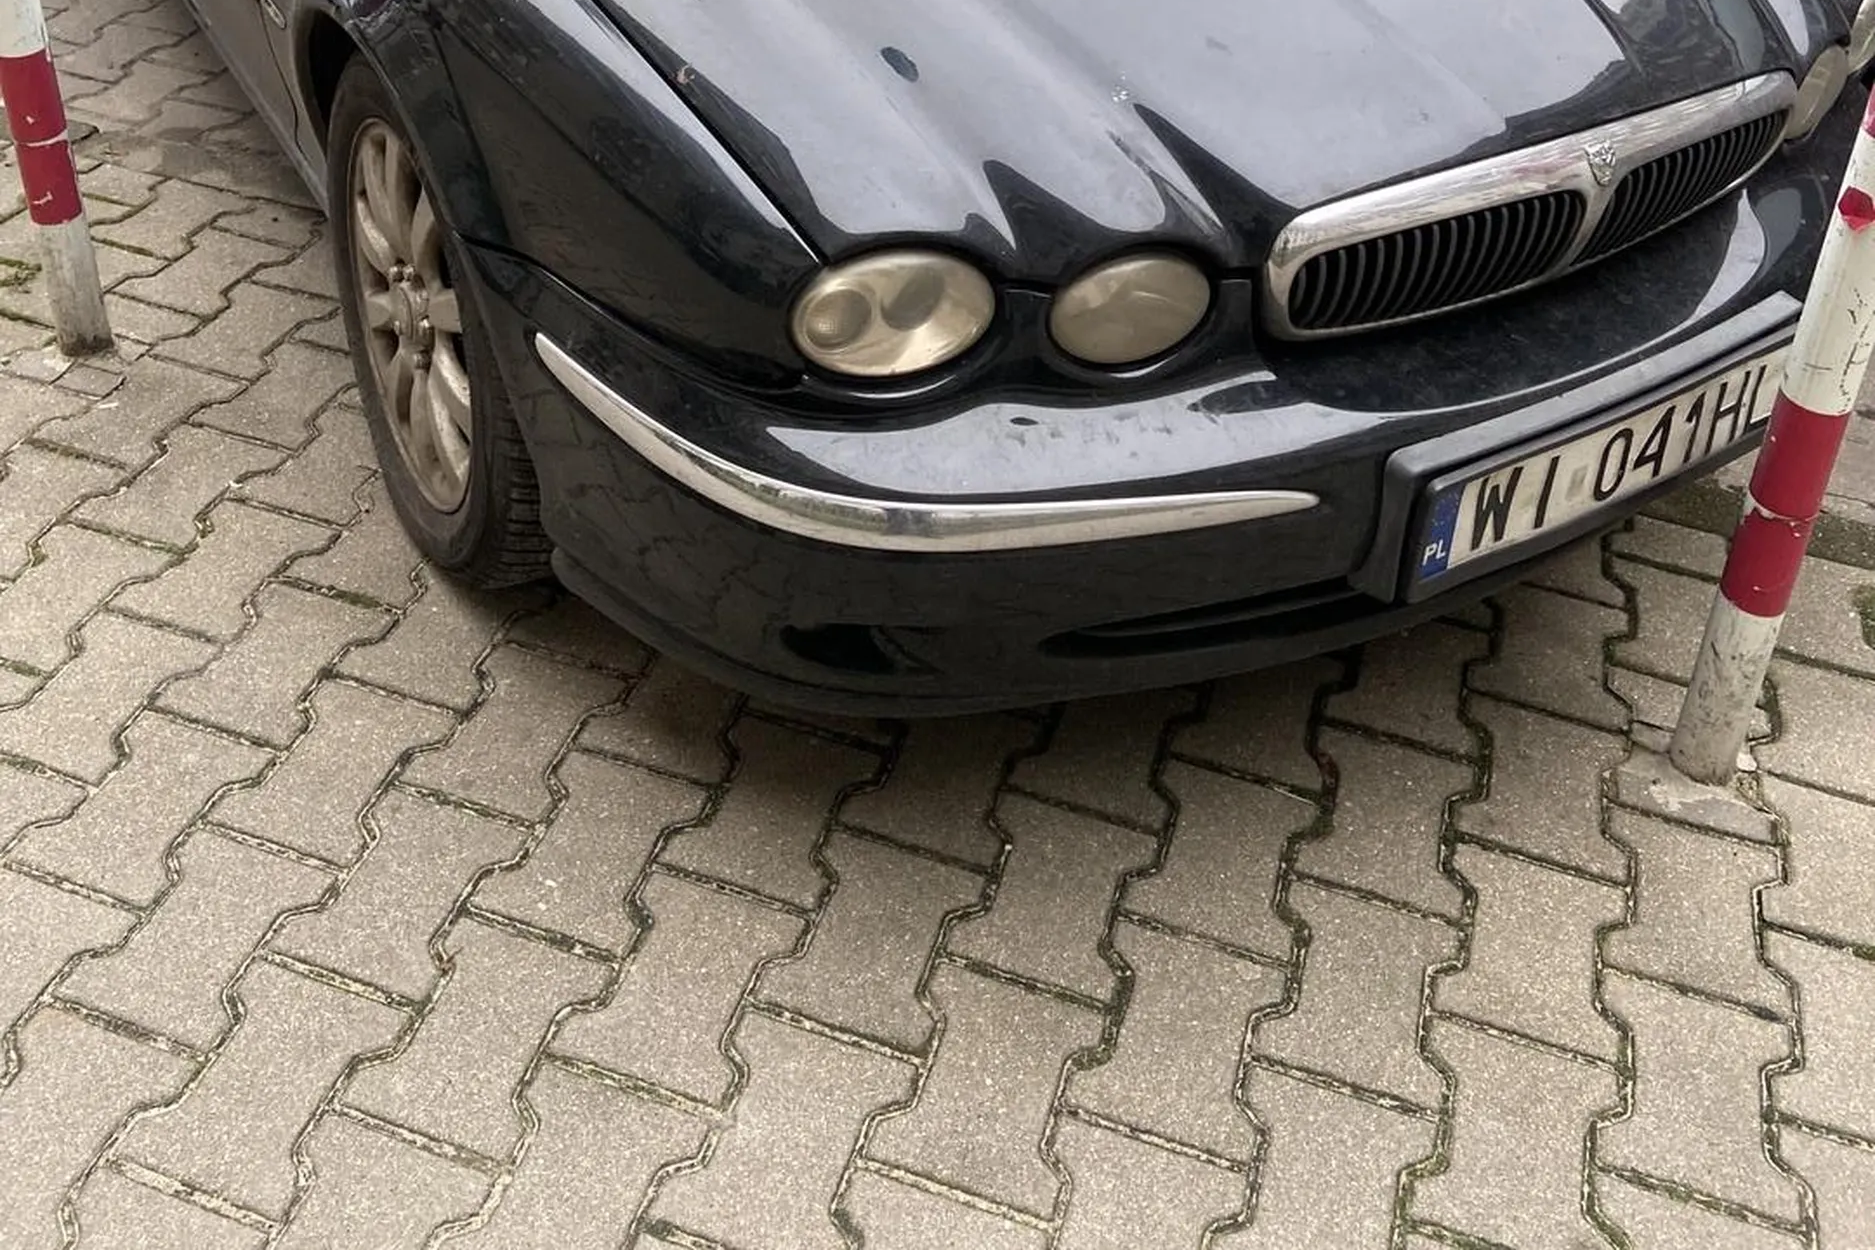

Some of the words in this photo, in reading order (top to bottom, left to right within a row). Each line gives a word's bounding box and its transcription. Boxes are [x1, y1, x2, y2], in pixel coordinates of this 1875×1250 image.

[1470, 455, 1561, 551] WI
[1593, 364, 1771, 501] 041HL
[1422, 539, 1446, 566] PL
